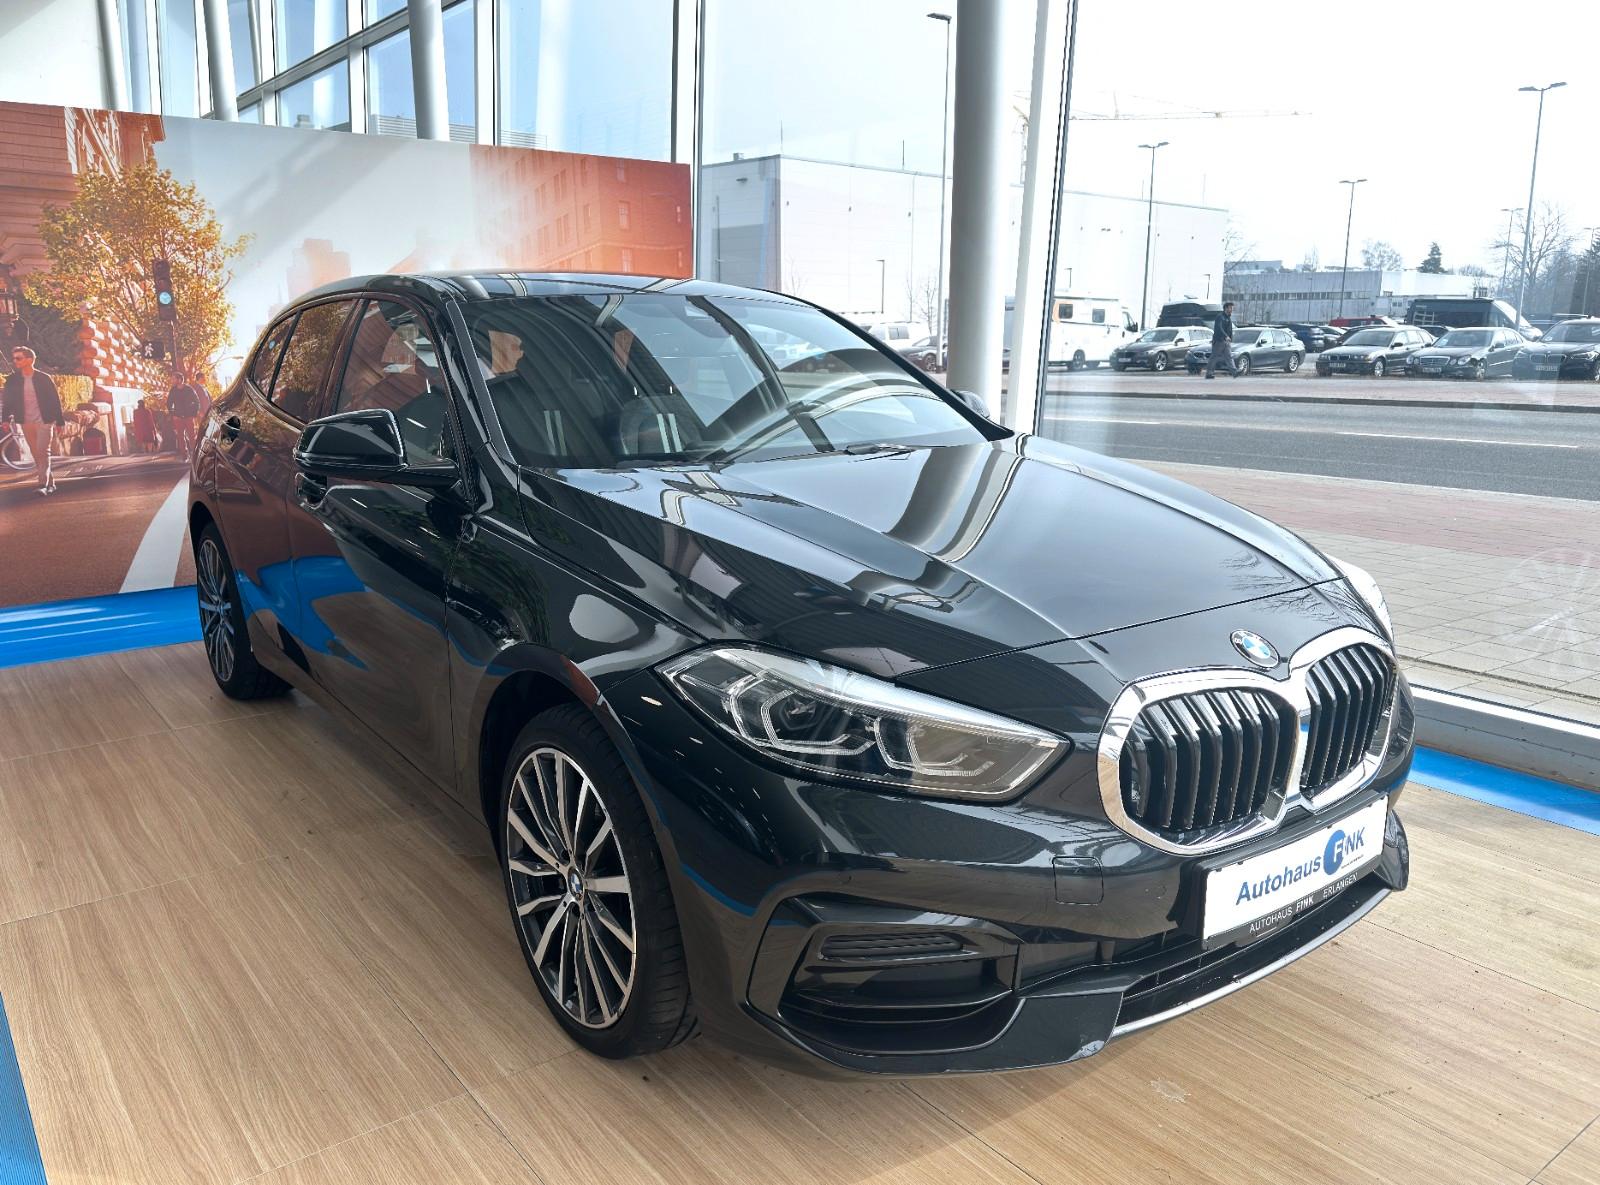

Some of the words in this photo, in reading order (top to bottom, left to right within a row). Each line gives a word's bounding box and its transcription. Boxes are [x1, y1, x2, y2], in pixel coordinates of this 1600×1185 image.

[1235, 854, 1322, 905] Autohaus
[1333, 826, 1365, 863] FINK
[1249, 906, 1293, 933] AUTOHAUS
[1295, 895, 1314, 912] FINK
[1322, 872, 1357, 899] ERLANGEN
